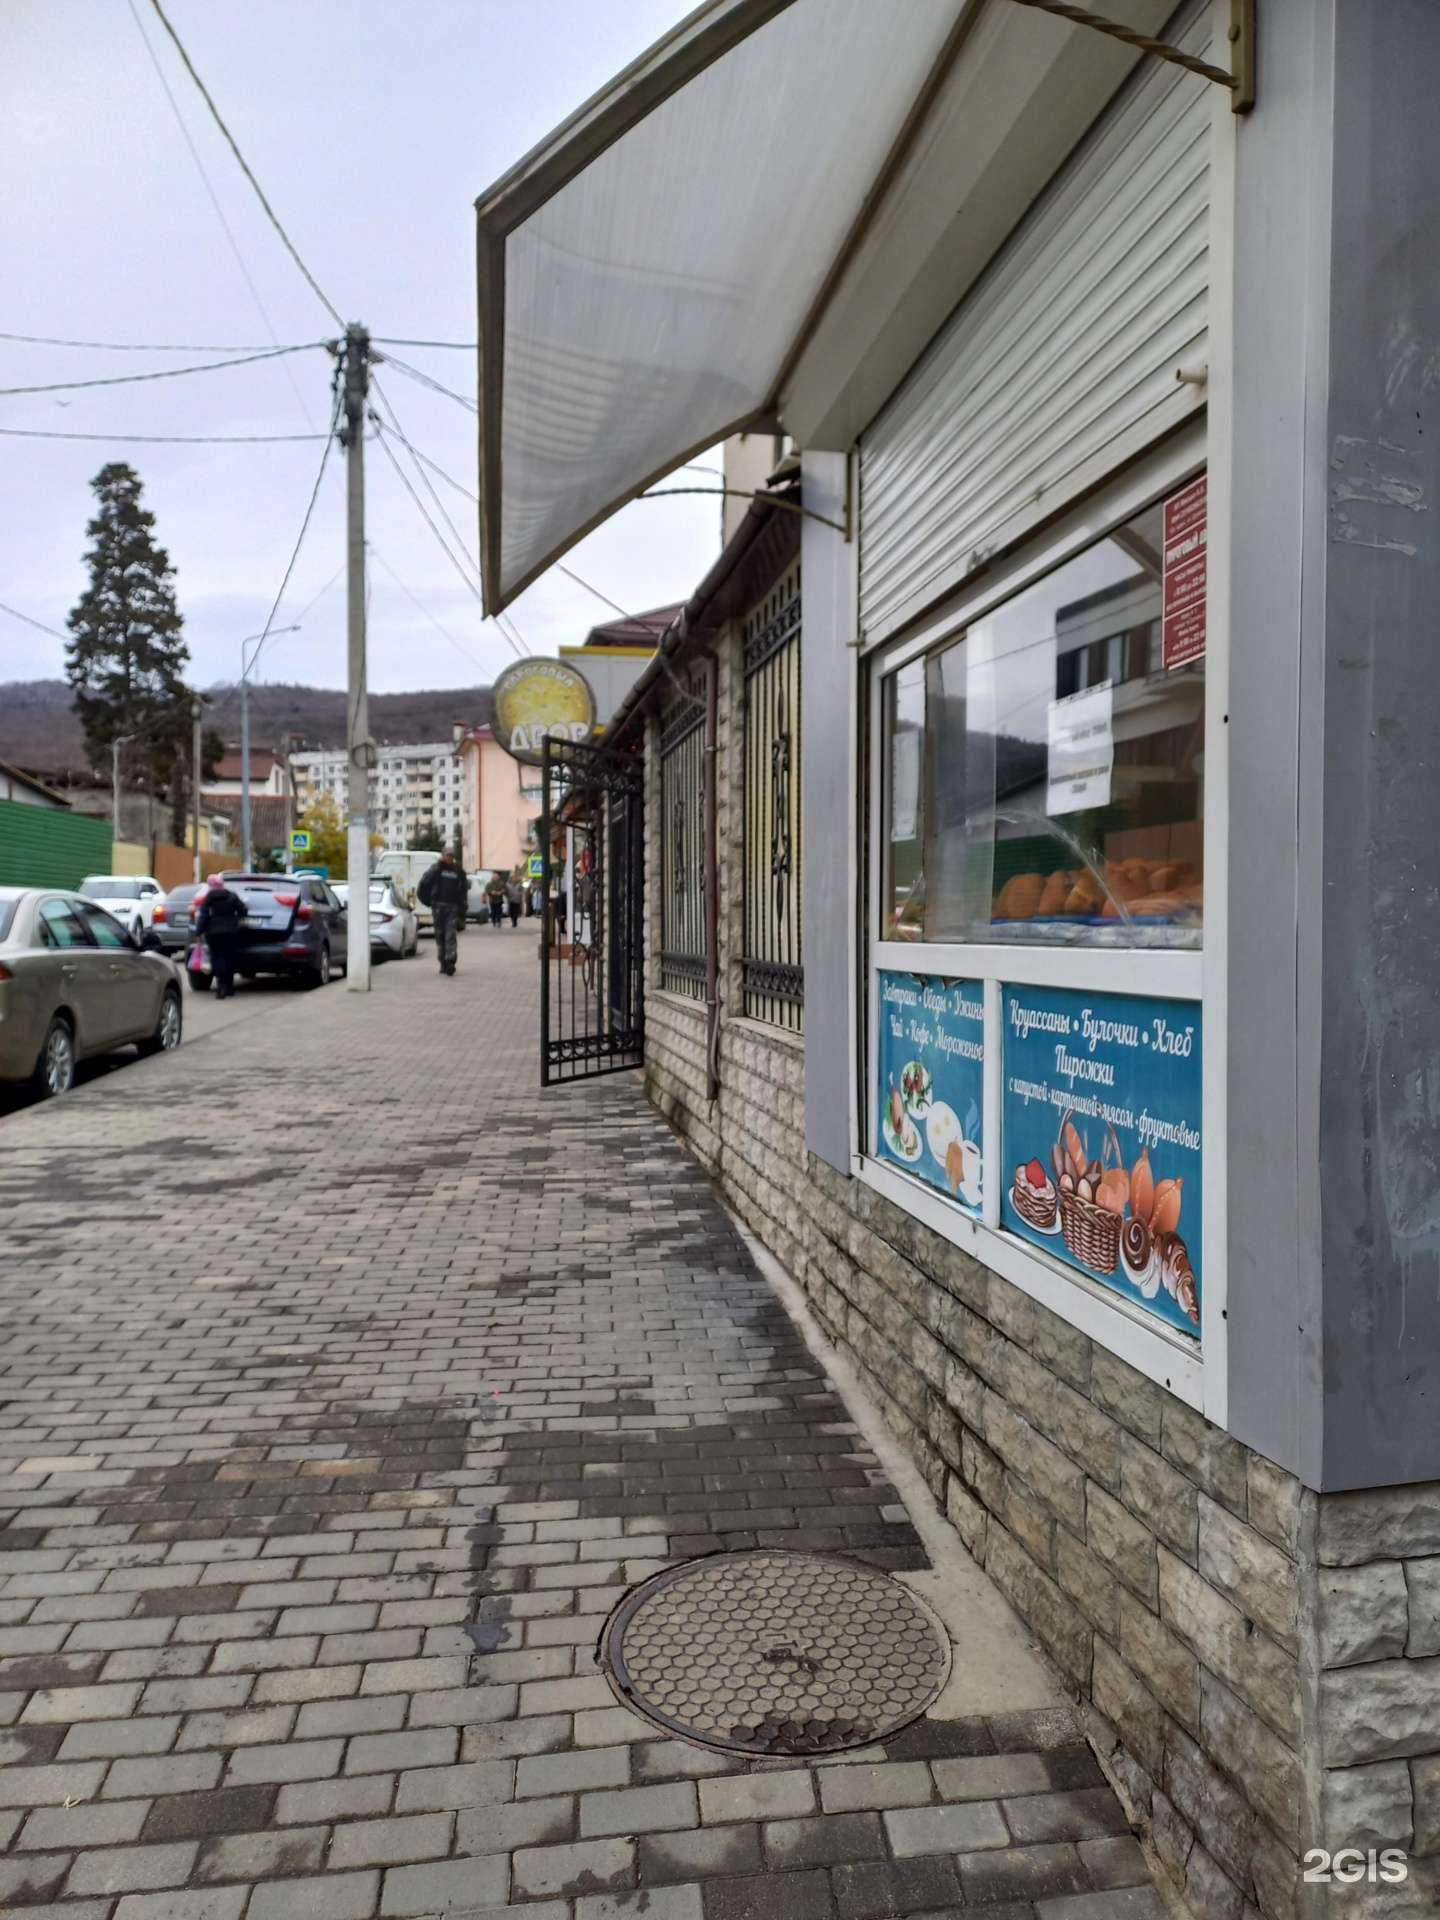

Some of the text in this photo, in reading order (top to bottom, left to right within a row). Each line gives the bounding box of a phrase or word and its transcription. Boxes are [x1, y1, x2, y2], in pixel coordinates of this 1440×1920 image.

[883, 979, 917, 1013] Завтраки
[923, 986, 947, 1021] Обеды
[890, 1015, 984, 1062] Чай Кофе Мороженое
[1010, 999, 1194, 1058] Круассаны Булочки Хлеб
[1055, 1044, 1115, 1089] Пирожки
[1008, 1077, 1201, 1150] с капустой картошкой мясом фруктовые
